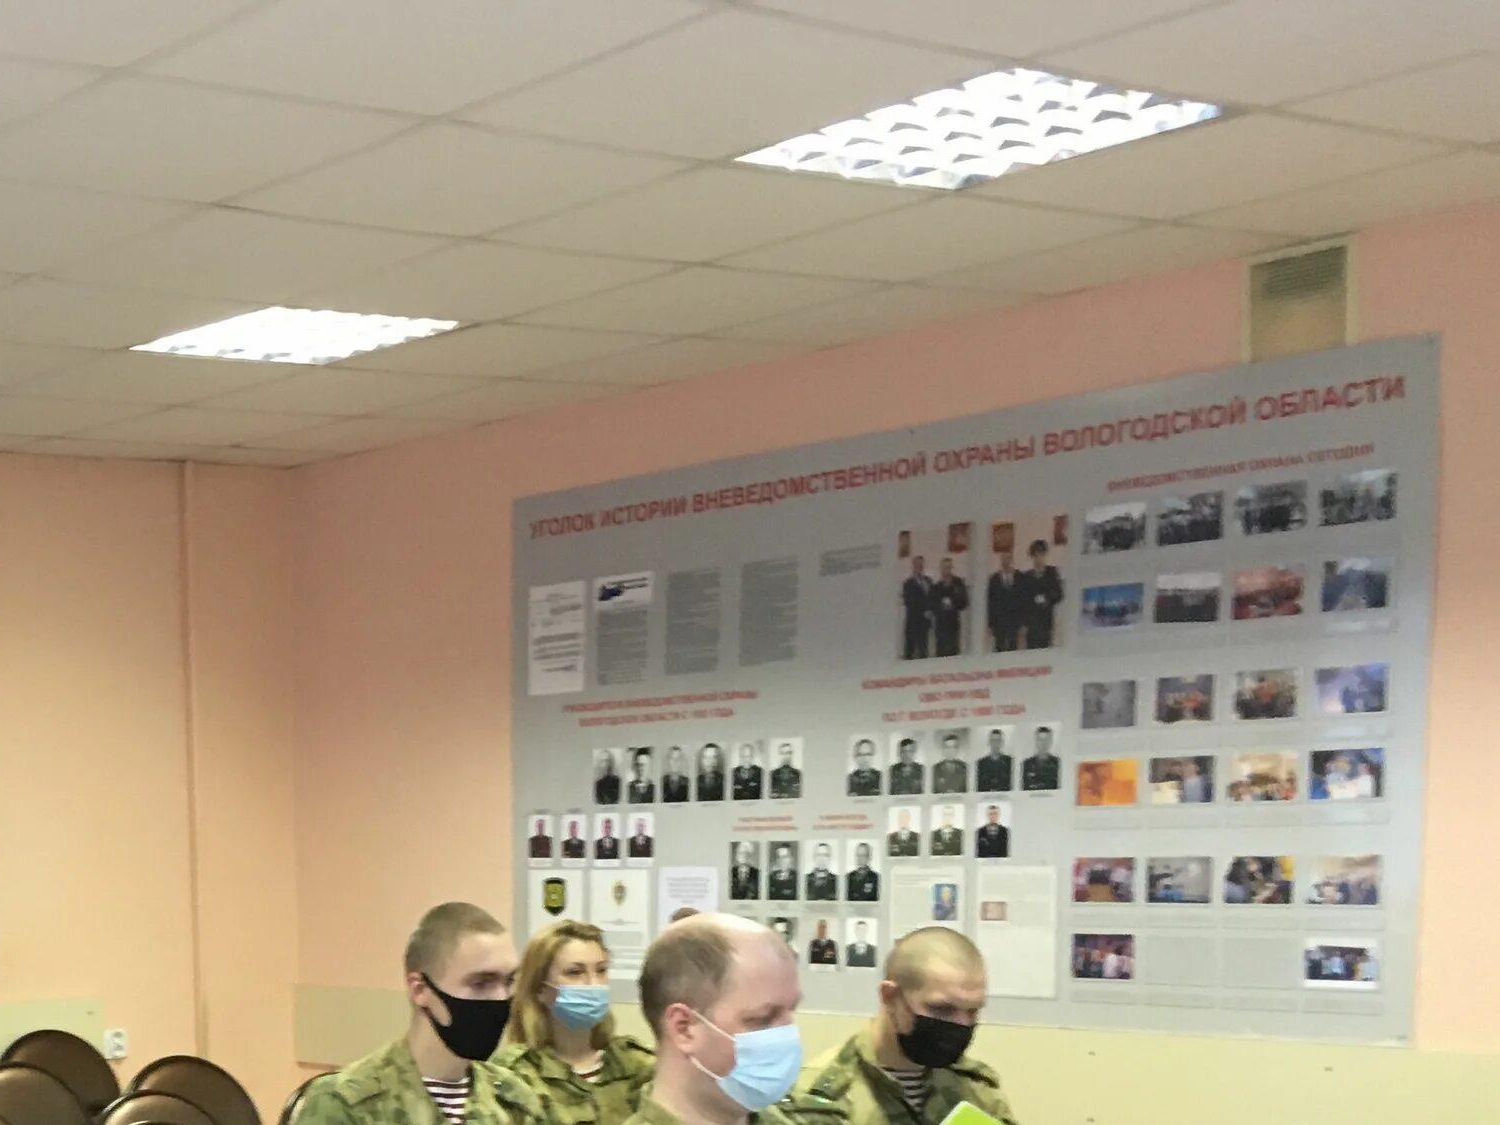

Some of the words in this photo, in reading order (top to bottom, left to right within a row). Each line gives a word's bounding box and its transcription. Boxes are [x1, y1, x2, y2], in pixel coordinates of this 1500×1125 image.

[529, 512, 595, 540] УГОЛОК
[600, 494, 687, 528] ИСТОРИИ
[692, 451, 927, 513] ВНЕВЕДОМСТВЕННОЙ
[933, 437, 1035, 475] ОХРАНЫ
[1044, 396, 1247, 456] ВОЛОГОДСКОЙ
[1254, 375, 1406, 421] ОБЛАСТИ
